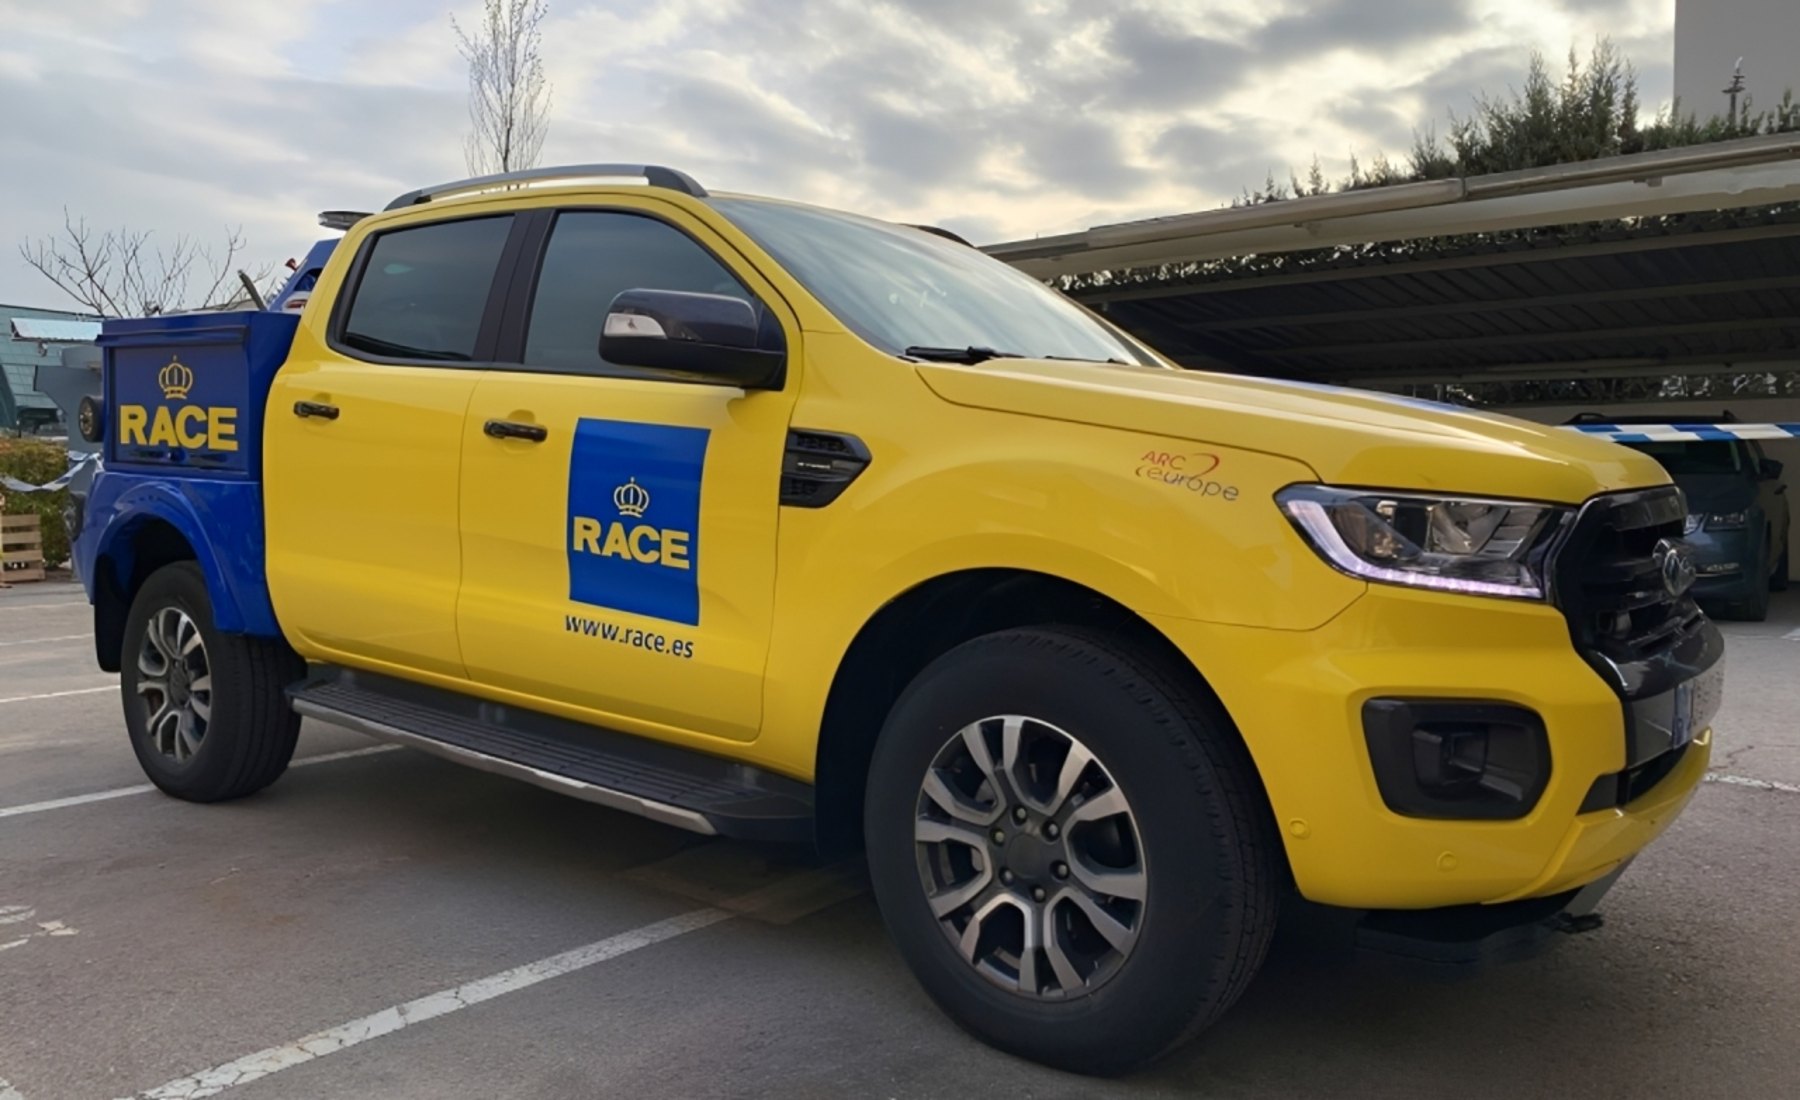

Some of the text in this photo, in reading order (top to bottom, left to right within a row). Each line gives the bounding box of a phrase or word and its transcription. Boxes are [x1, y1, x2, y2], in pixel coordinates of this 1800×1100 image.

[119, 405, 239, 451] RACE
[1141, 450, 1186, 470] ARC
[1147, 467, 1239, 501] europe
[573, 516, 690, 570] RACE
[565, 615, 694, 659] www.race.es
